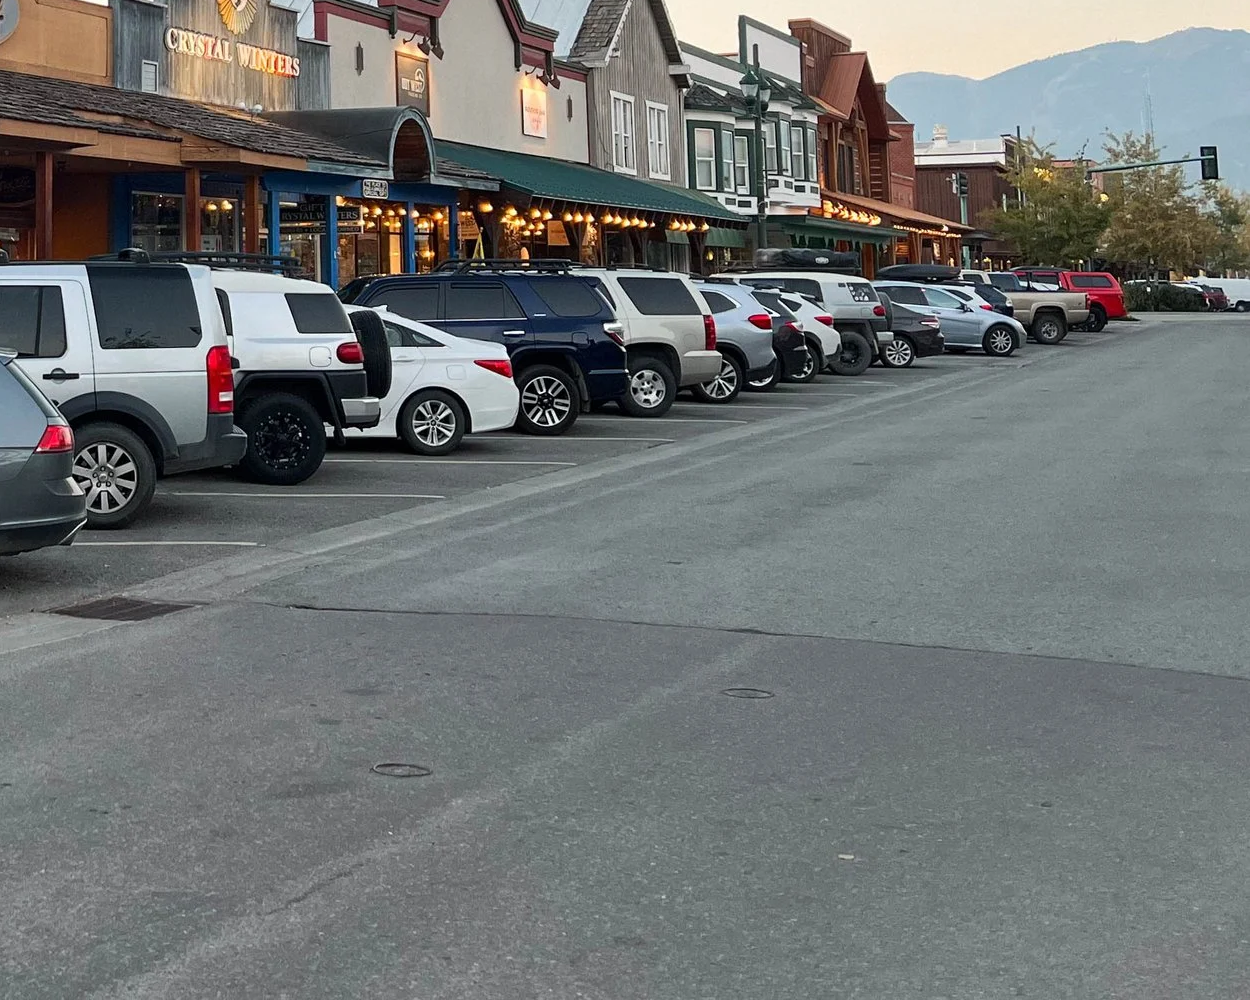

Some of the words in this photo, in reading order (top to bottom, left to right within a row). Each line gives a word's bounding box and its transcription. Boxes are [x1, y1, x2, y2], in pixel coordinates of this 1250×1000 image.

[164, 27, 232, 63] CRYSTAL
[236, 42, 300, 77] WINTERS
[281, 211, 316, 220] RYSTAL
